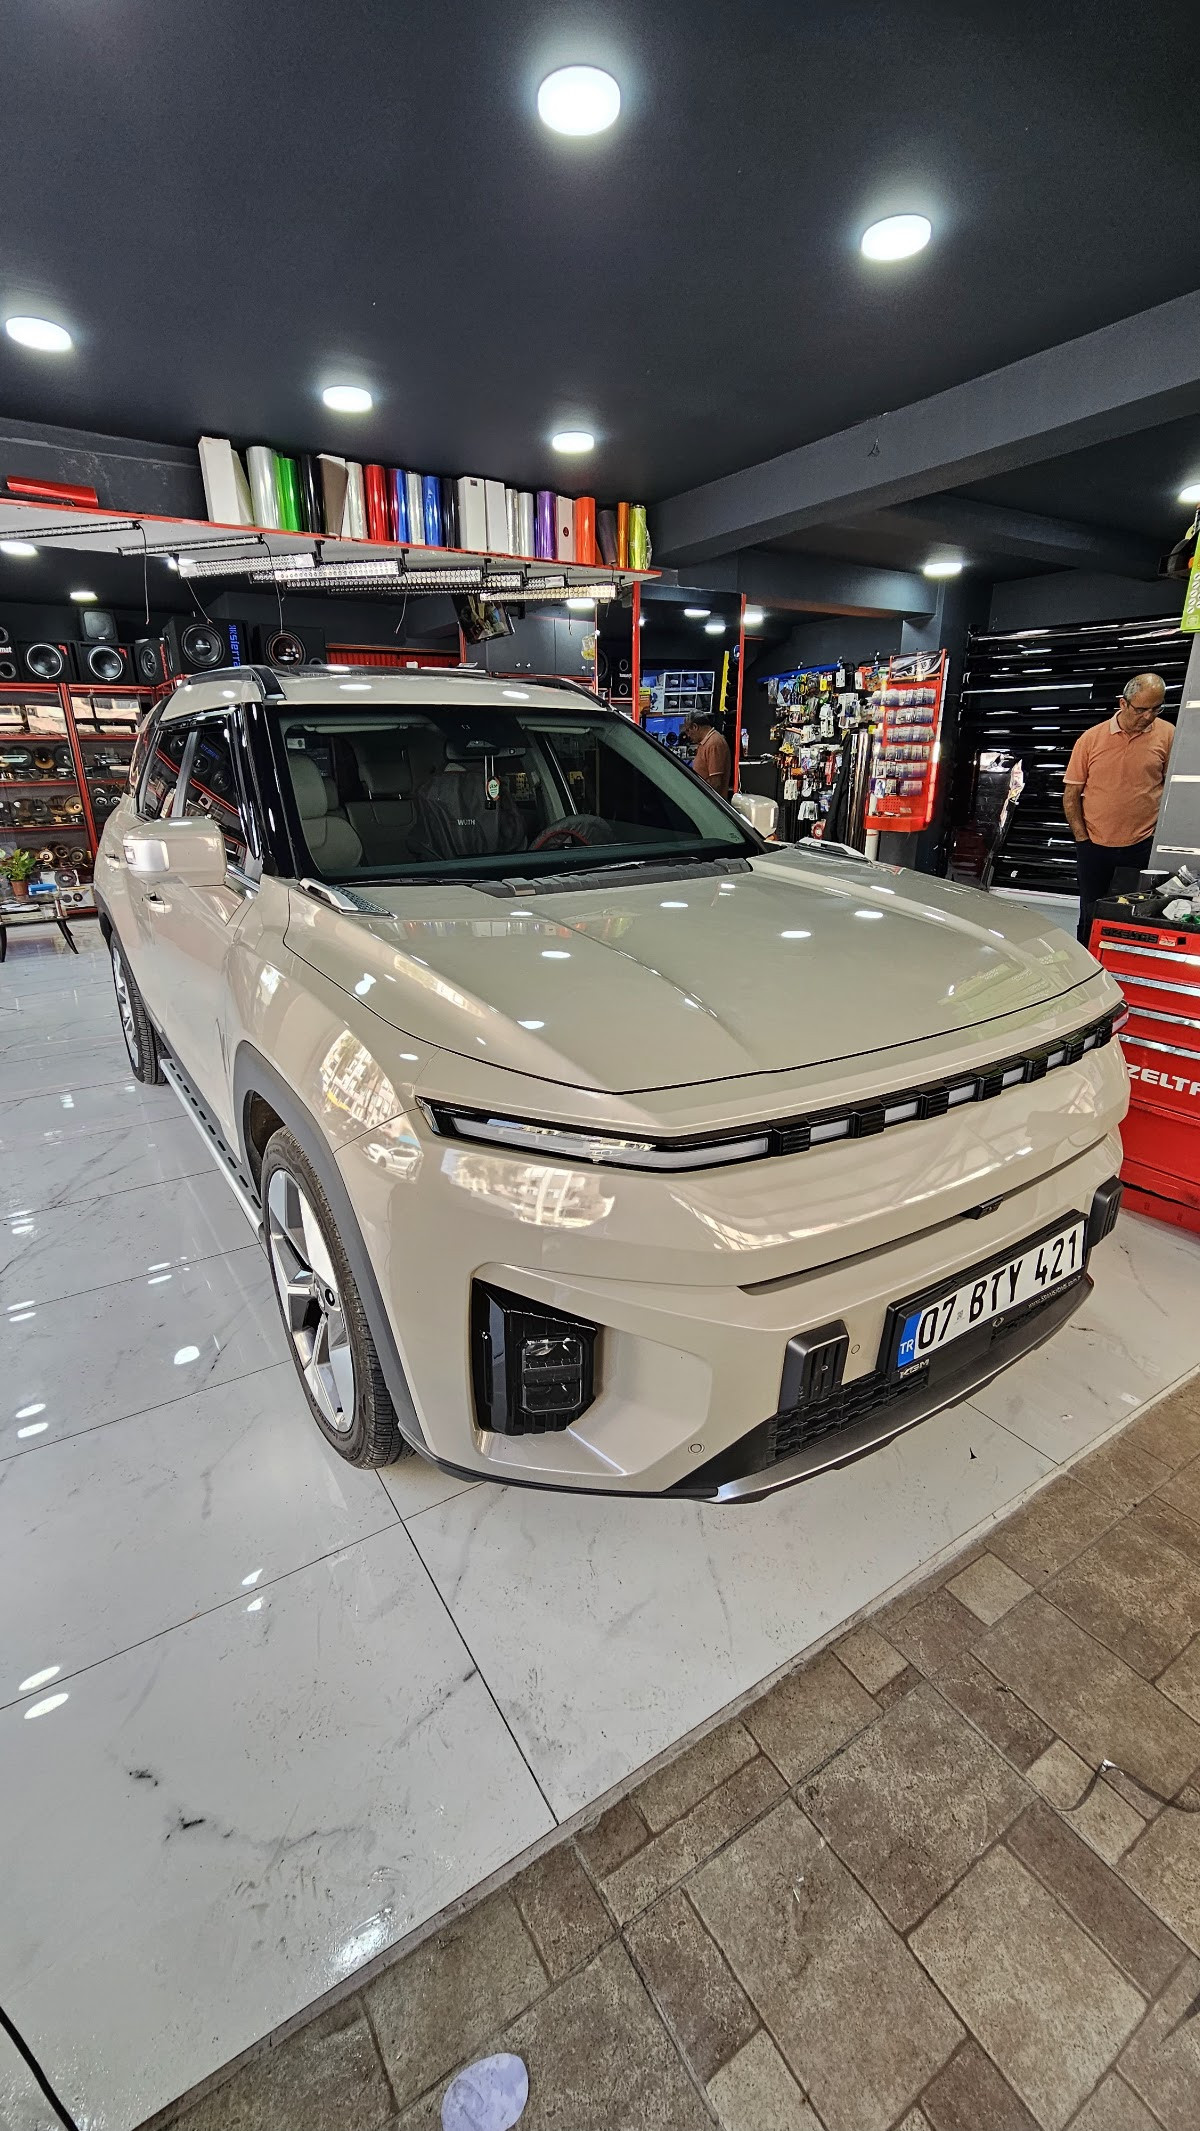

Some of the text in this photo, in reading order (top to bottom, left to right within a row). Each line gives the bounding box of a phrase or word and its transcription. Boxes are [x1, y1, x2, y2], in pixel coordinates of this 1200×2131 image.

[918, 1230, 1077, 1350] 07 BTY 421
[900, 1338, 914, 1355] TR
[899, 1358, 930, 1379] KGM
